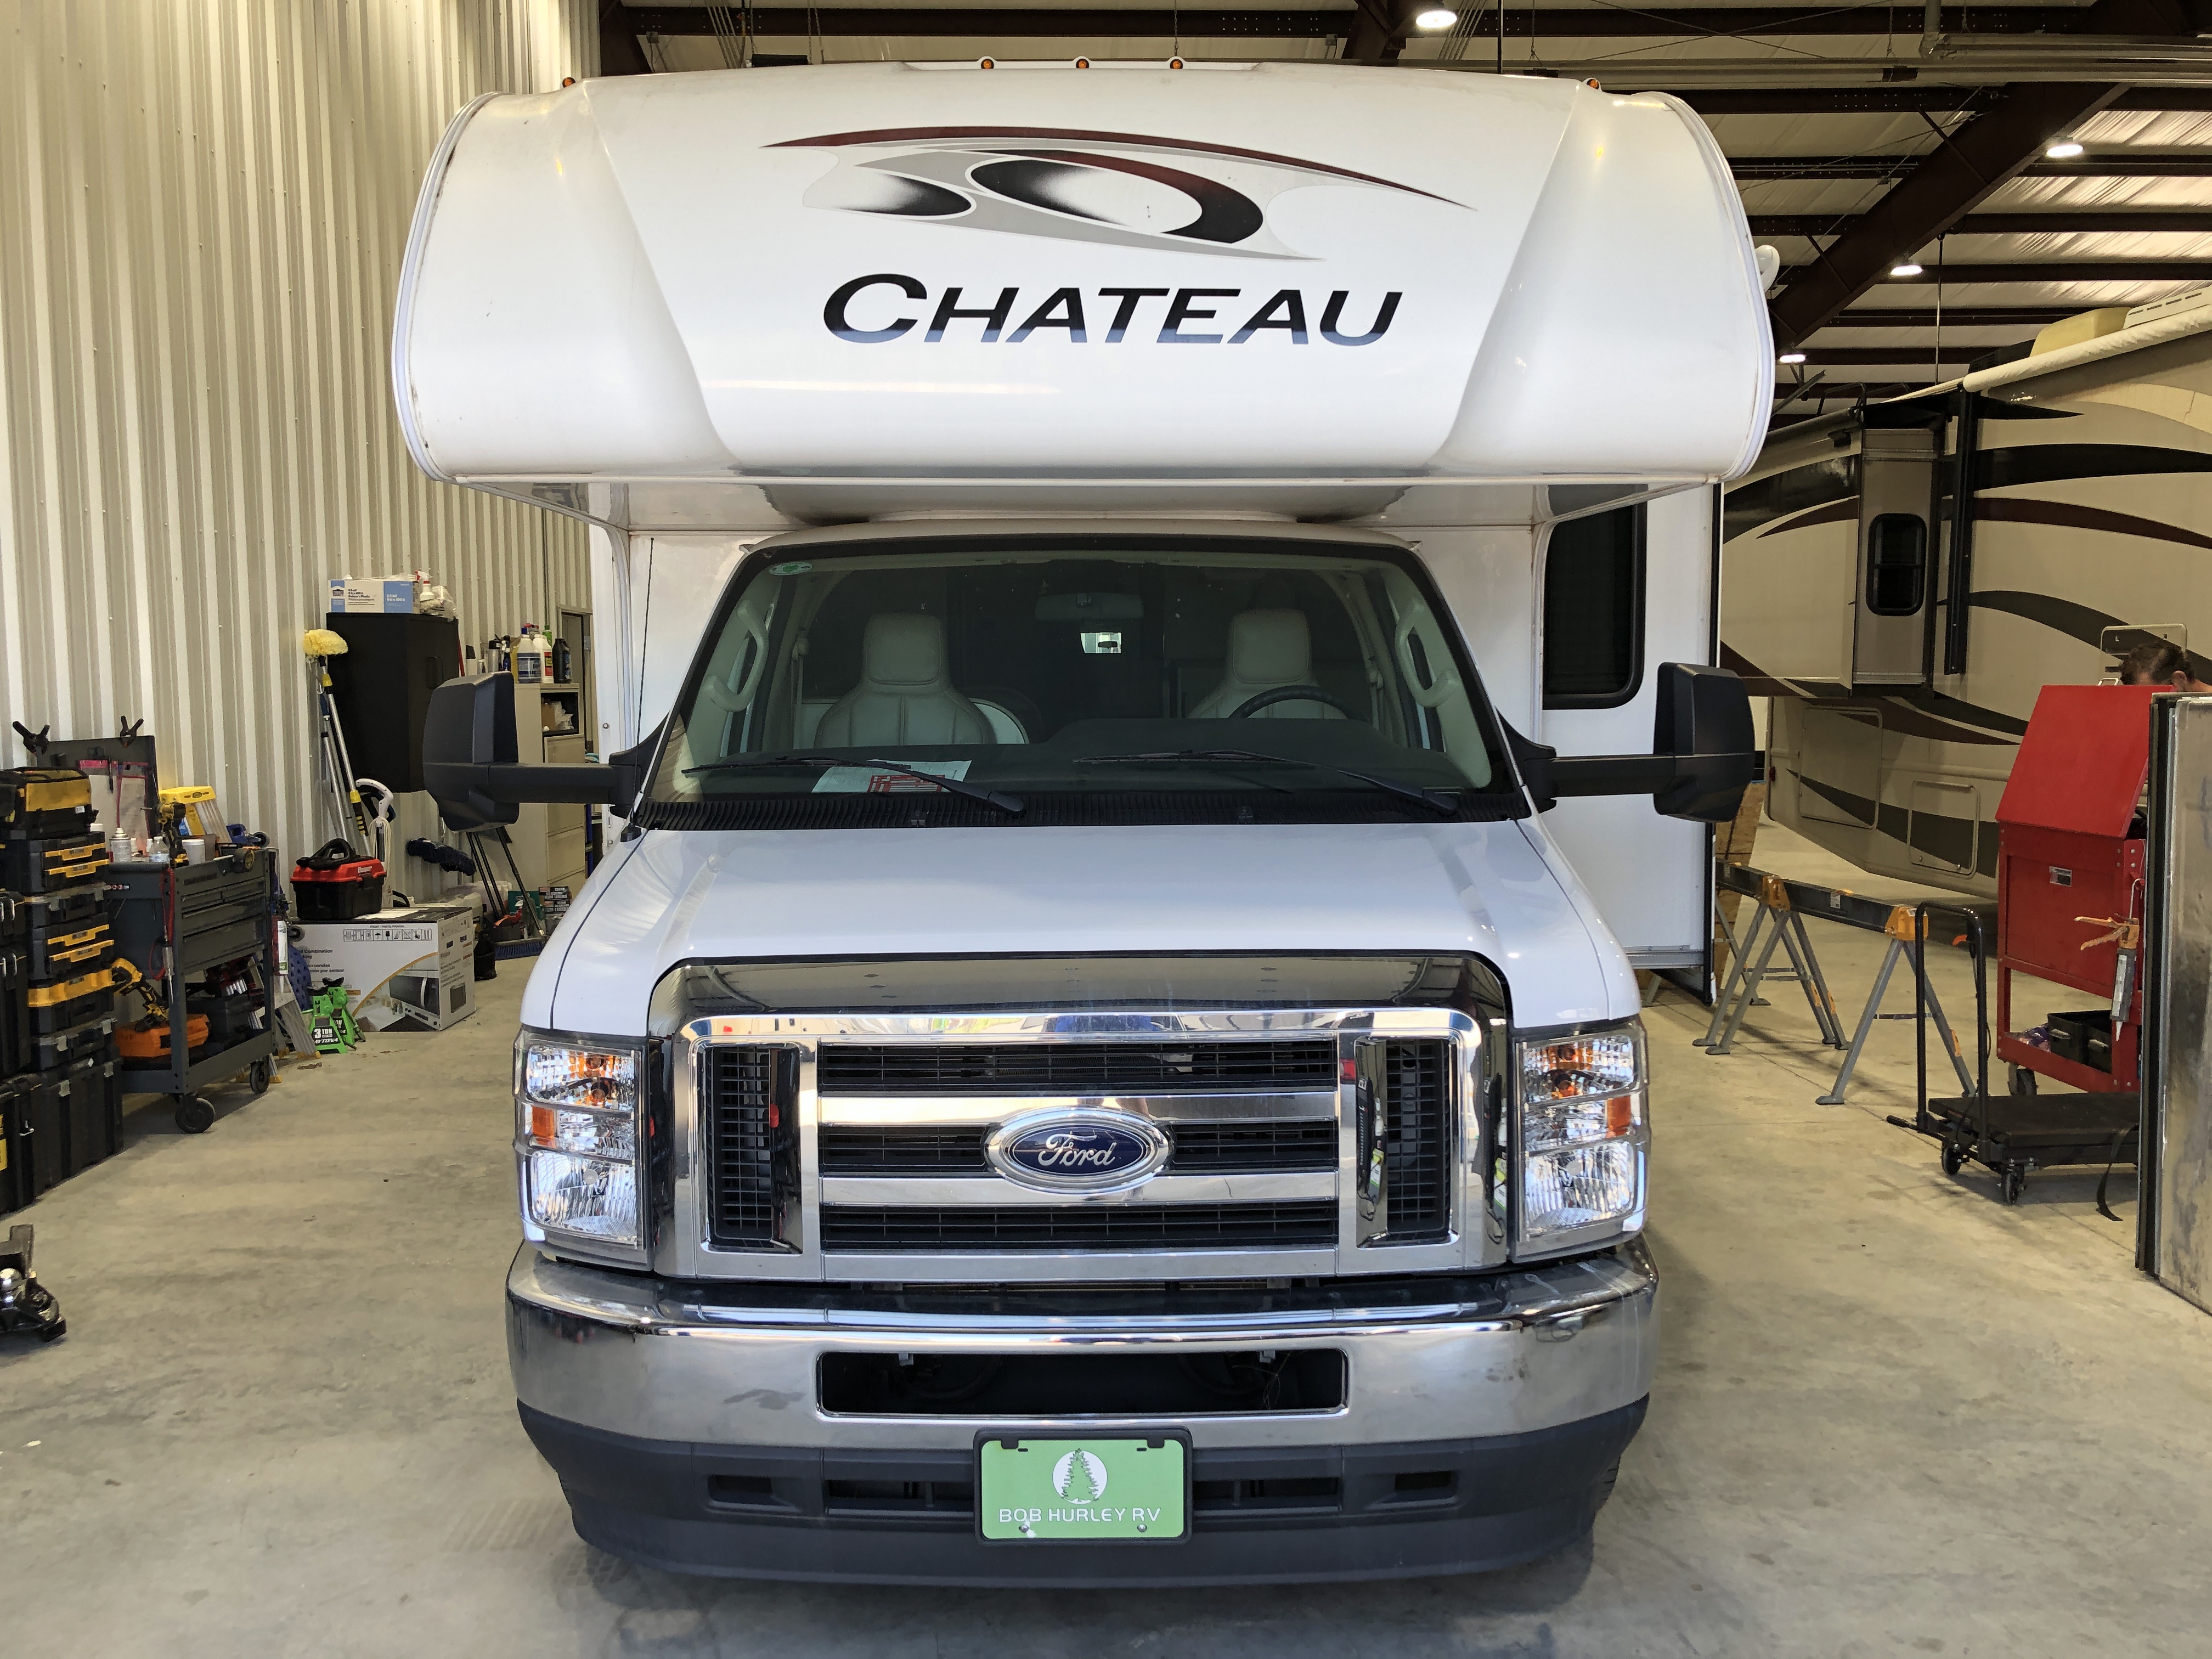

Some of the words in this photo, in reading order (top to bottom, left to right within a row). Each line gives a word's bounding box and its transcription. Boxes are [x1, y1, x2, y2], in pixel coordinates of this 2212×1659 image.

[822, 272, 1404, 347] CHATEAU
[314, 1028, 321, 1039] 3
[1038, 1133, 1117, 1167] Ford
[998, 1508, 1042, 1522] BOB
[1048, 1508, 1127, 1522] HURLEY
[1132, 1508, 1161, 1522] RV
